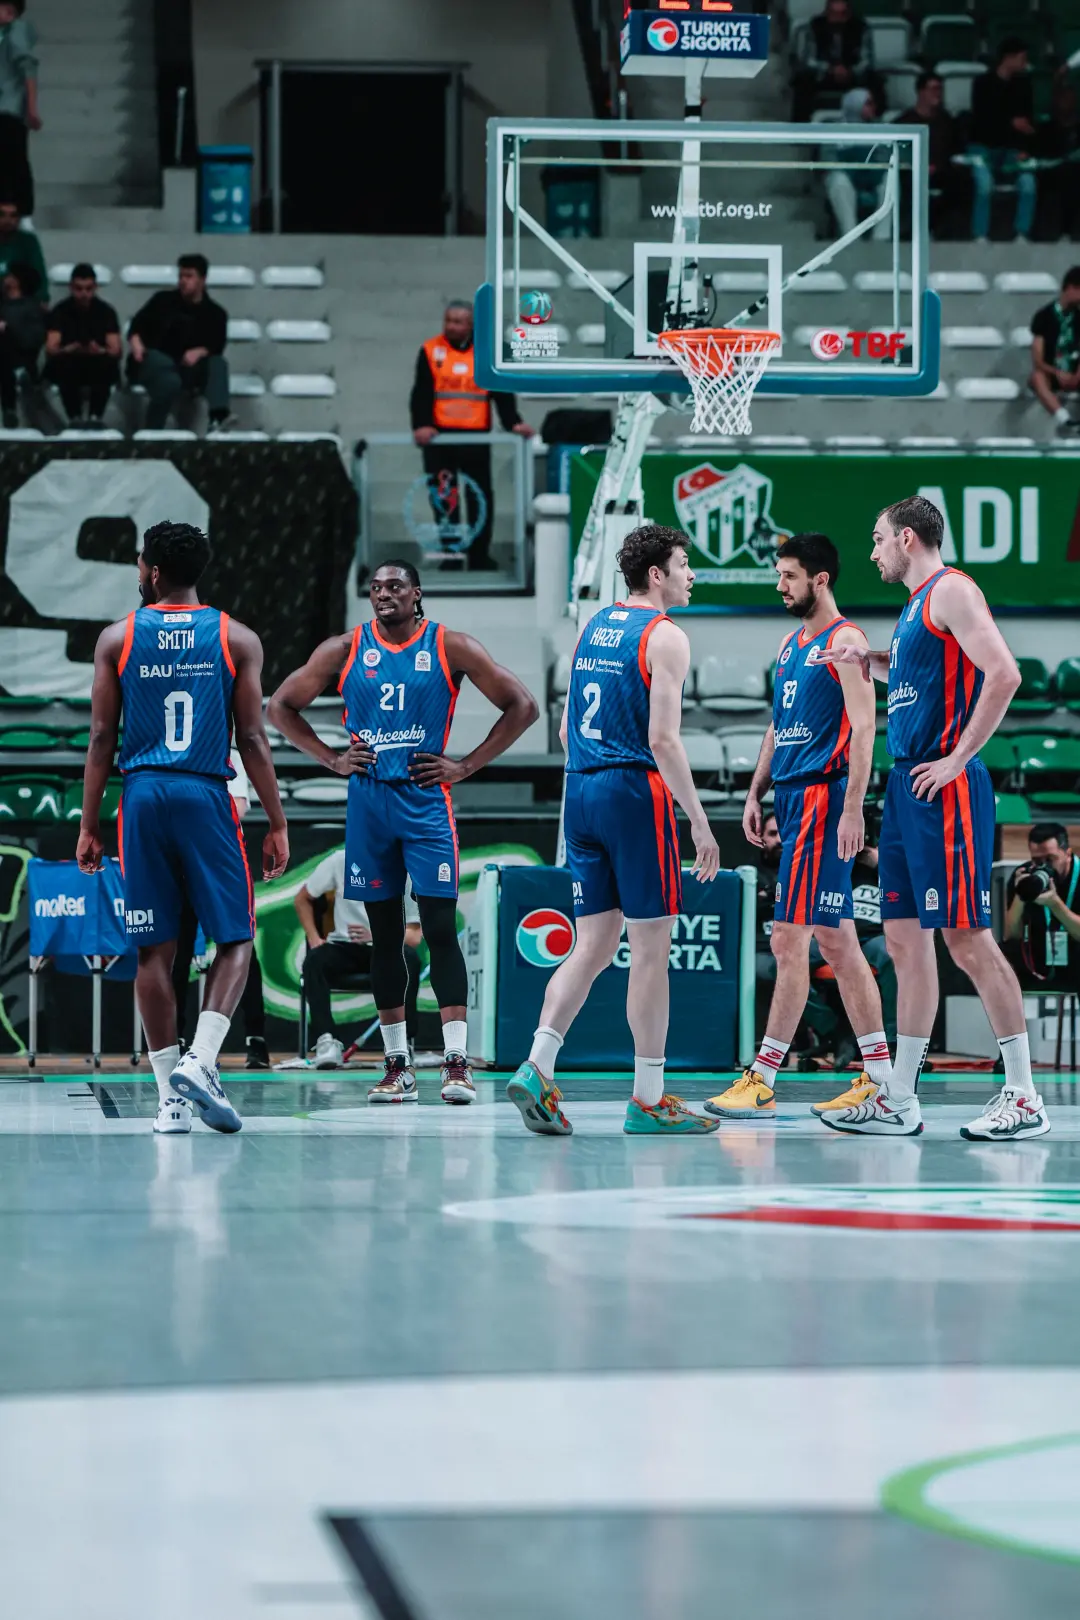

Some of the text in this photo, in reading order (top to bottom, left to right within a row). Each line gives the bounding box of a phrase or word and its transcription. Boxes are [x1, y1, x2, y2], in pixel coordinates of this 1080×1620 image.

[846, 331, 906, 359] TBF
[157, 629, 195, 650] SMITH
[590, 626, 625, 648] HAZER
[140, 664, 172, 679] BAU
[575, 656, 596, 671] BAU
[379, 682, 406, 711] 21
[164, 690, 193, 752] 0
[580, 682, 602, 740] 2
[350, 875, 366, 886] BAU
[125, 909, 154, 926] HDI
